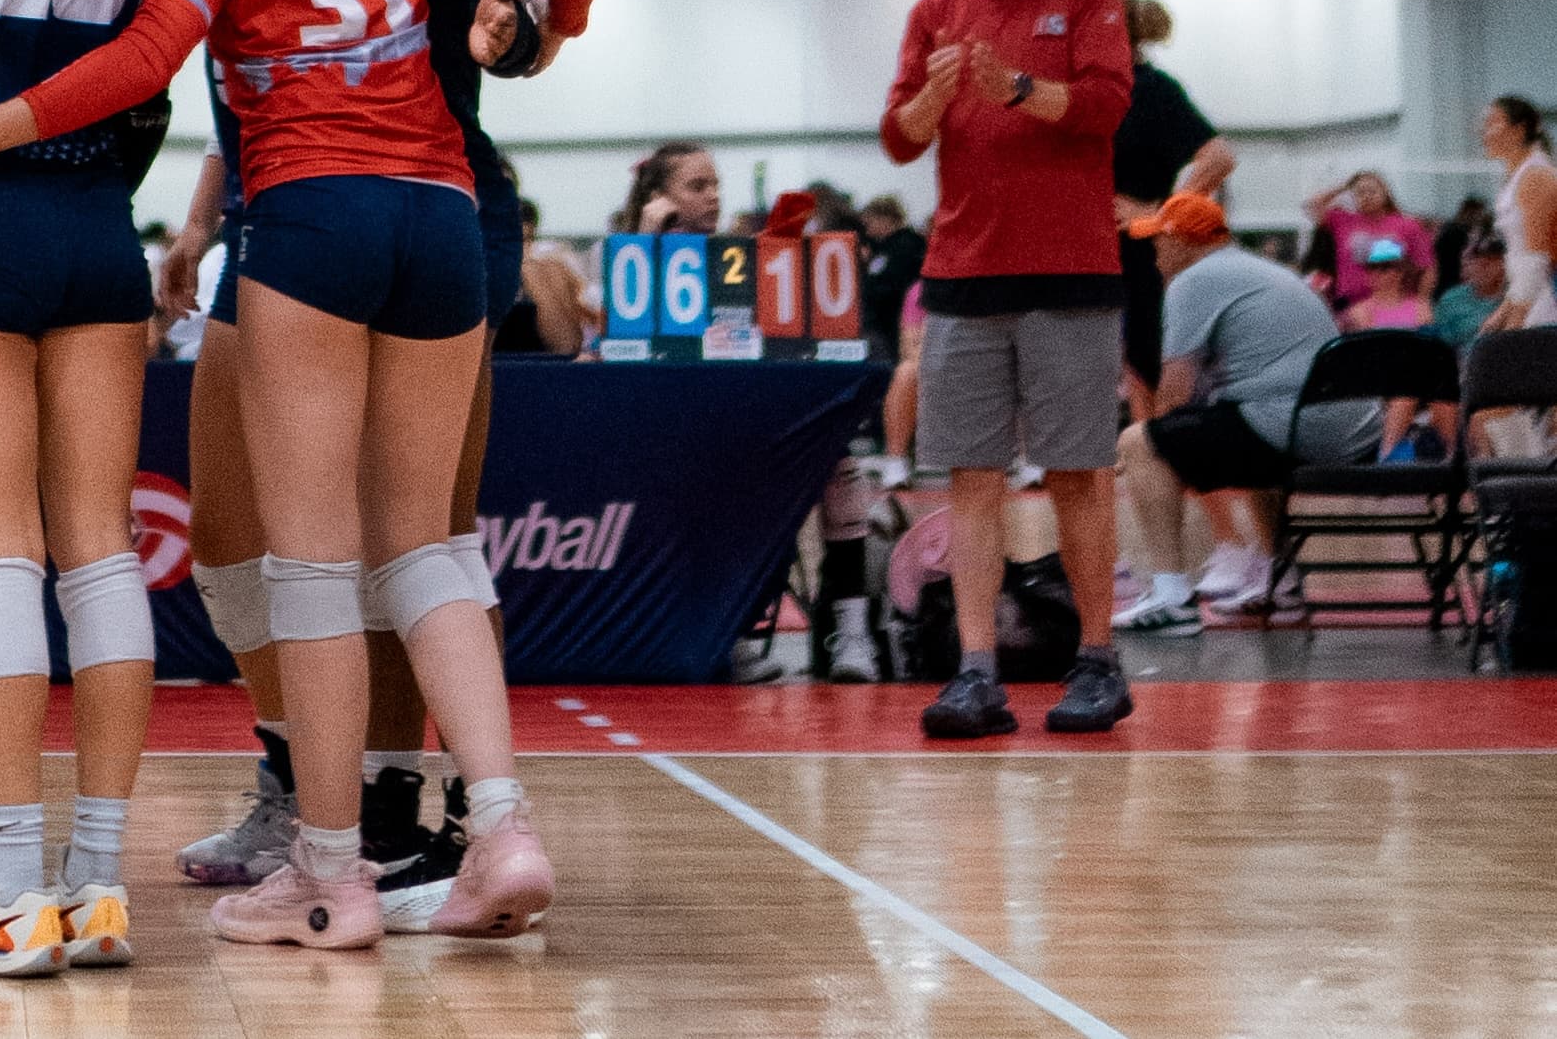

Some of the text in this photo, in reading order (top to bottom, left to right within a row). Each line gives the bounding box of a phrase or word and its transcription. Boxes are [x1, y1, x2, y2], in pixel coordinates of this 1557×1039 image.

[611, 240, 853, 325] 06 2 10
